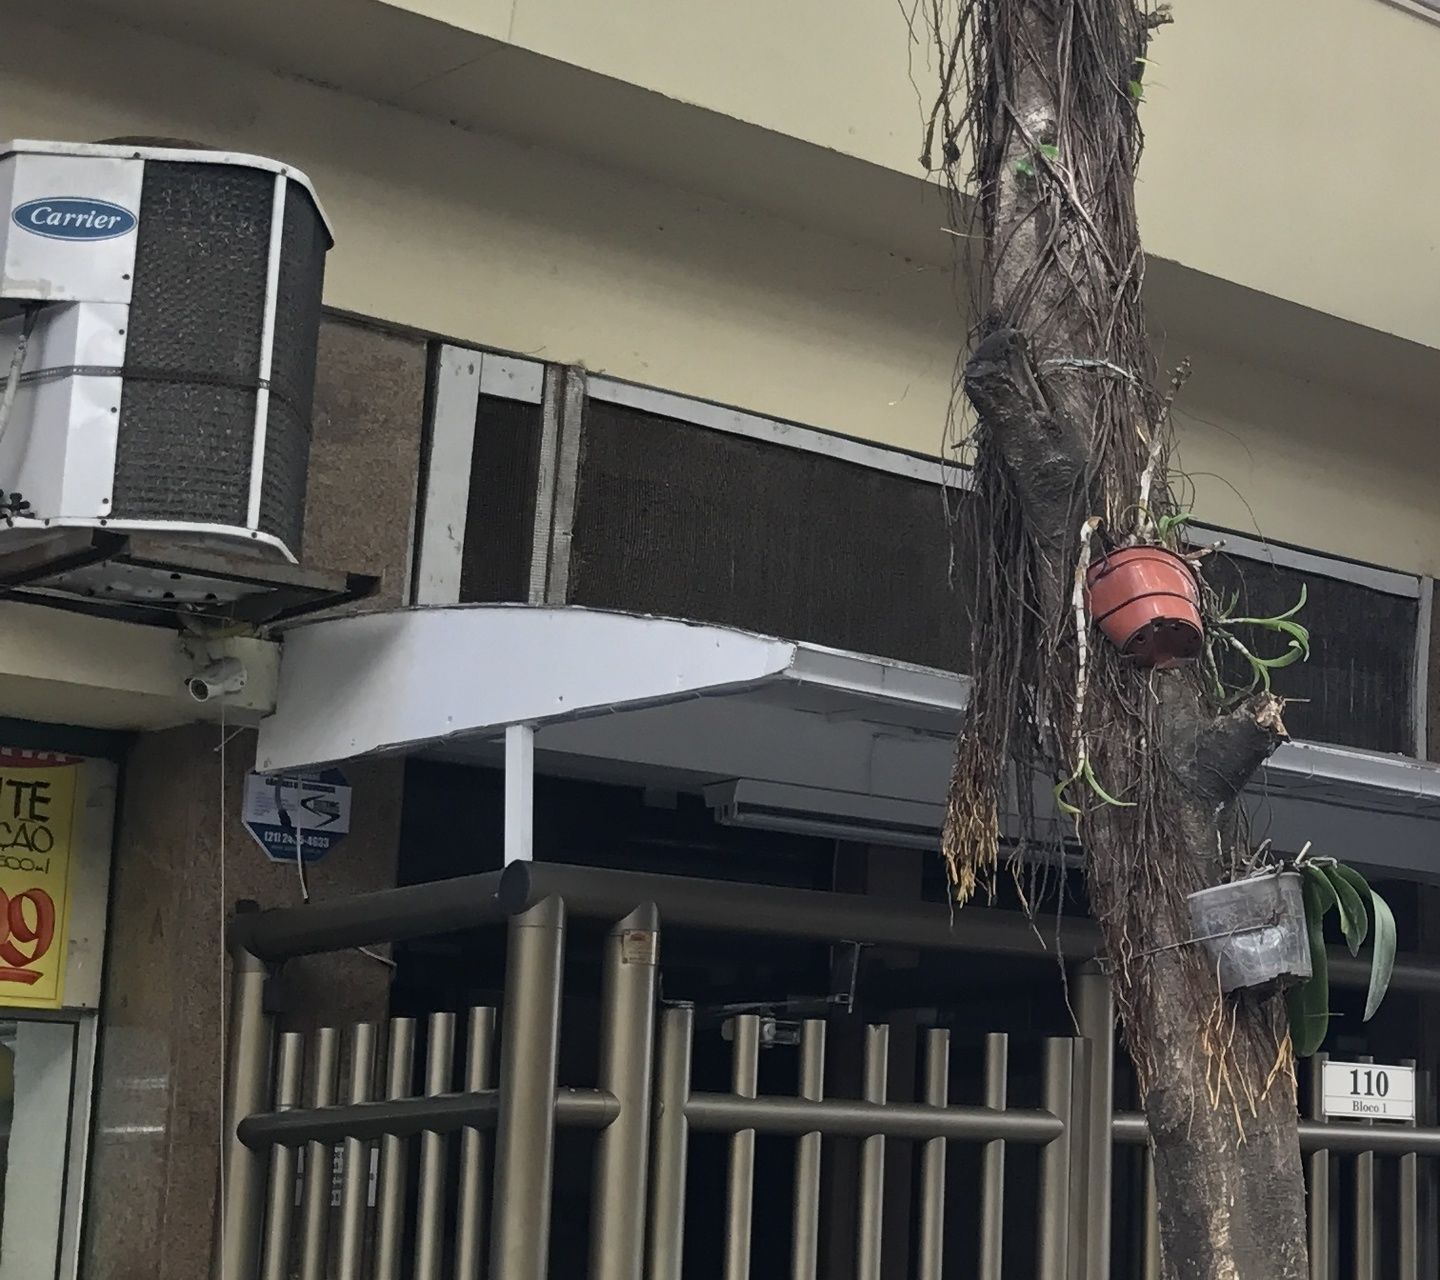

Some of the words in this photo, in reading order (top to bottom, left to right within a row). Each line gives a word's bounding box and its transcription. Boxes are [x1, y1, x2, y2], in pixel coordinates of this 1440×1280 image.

[30, 206, 121, 229] Carrier
[0, 777, 52, 822] TE
[0, 884, 56, 968] 9
[1350, 1069, 1389, 1097] 110
[1352, 1100, 1380, 1113] Bloco
[1382, 1103, 1387, 1113] 1
